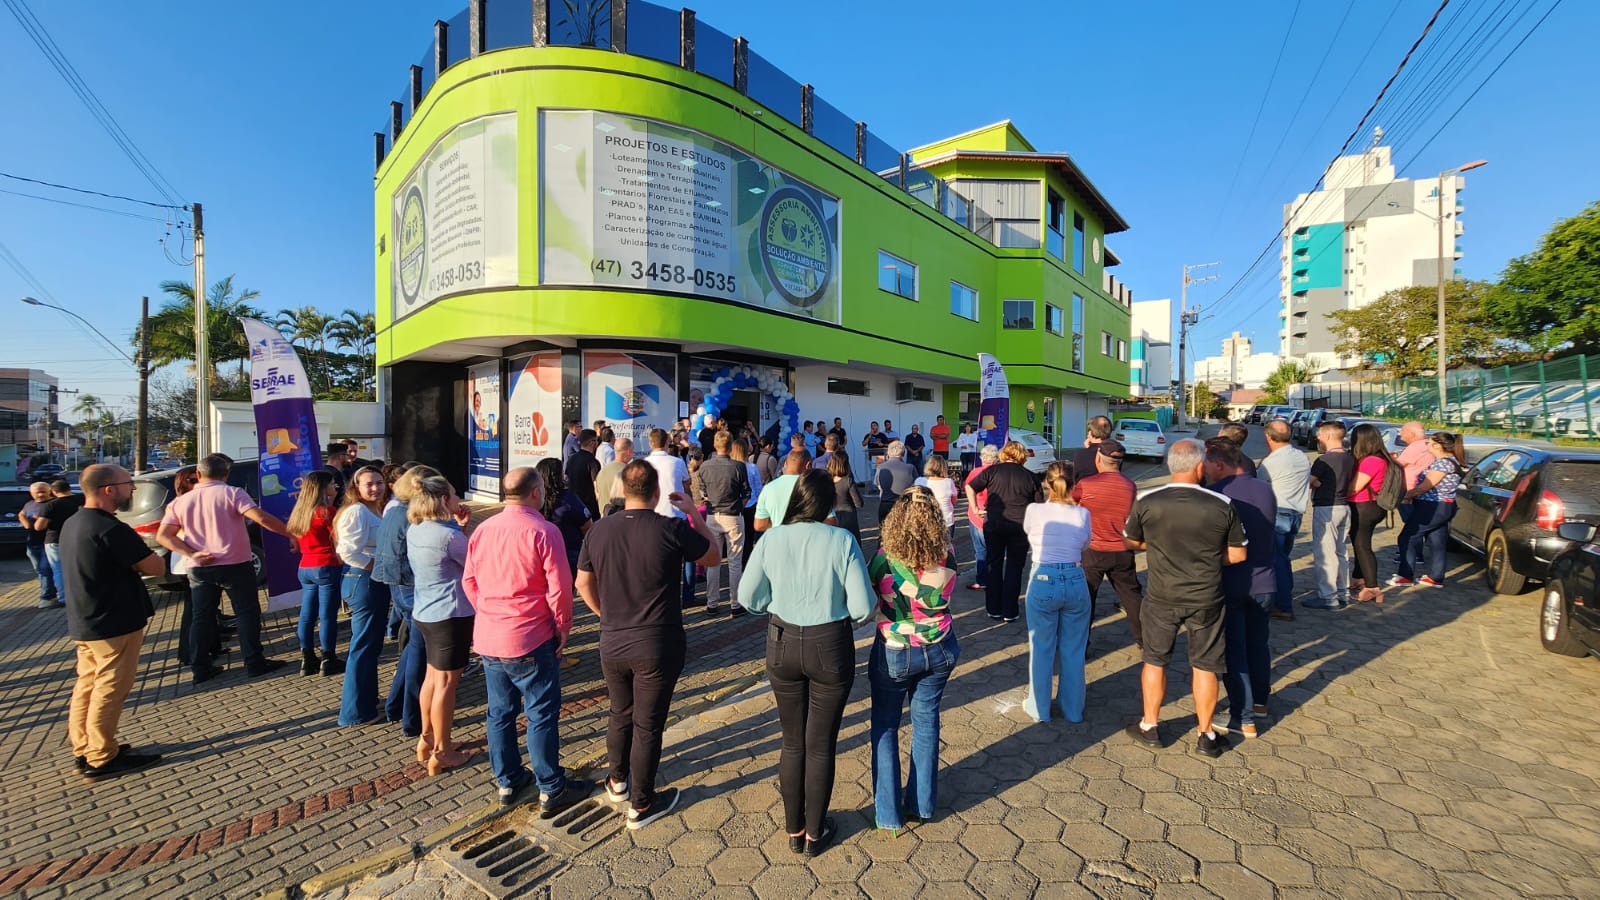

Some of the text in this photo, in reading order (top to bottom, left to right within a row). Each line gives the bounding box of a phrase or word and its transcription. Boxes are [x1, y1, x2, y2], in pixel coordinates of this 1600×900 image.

[605, 136, 726, 171] PROJETOS E ESTUDOS
[611, 153, 665, 167] Loteamentos
[667, 162, 681, 170] Res
[617, 165, 659, 178] Drenagem
[620, 178, 670, 191] Tratamentos
[648, 192, 686, 205] Florestais
[668, 207, 684, 216] EAS
[608, 212, 637, 222] Planos
[646, 216, 687, 229] Programas
[605, 224, 664, 237] Caracterização
[666, 229, 675, 238] de
[677, 233, 701, 243] cursos
[767, 200, 826, 259] ASSESSORIA AMBIENTAL
[620, 238, 658, 248] Unidades
[660, 242, 670, 250] de
[766, 244, 796, 262] SOLUÇÃO
[796, 255, 827, 273] AMBIENTAL
[590, 259, 736, 293] (47) 3458-0535
[252, 374, 295, 390] SEBRAE
[515, 414, 531, 428] Barra
[513, 430, 531, 445] Velha
